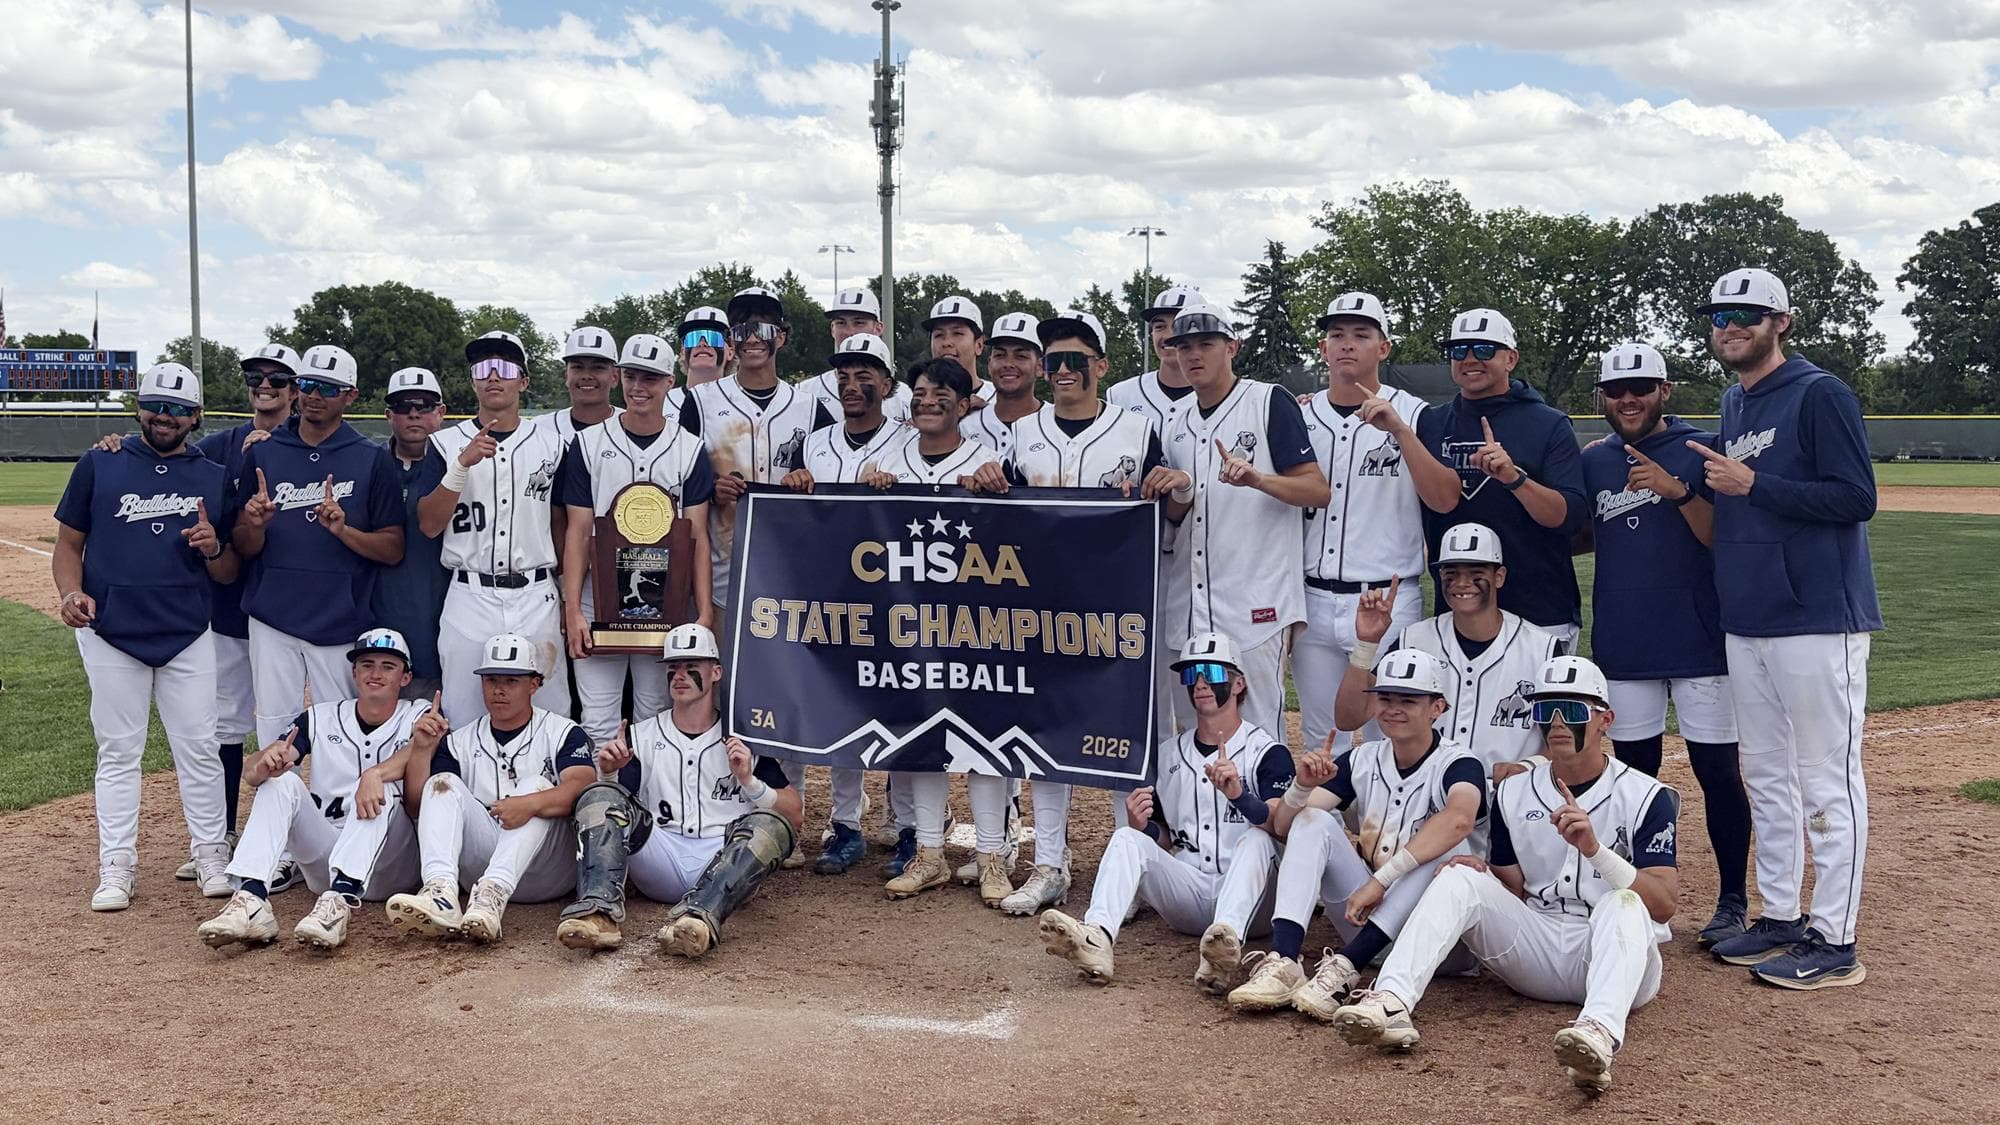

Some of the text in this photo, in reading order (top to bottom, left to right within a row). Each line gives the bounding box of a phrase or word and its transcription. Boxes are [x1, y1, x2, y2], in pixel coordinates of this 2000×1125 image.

[34, 353, 65, 361] STRIKE
[78, 353, 96, 361] OUT
[272, 480, 354, 508] Bulldgs
[453, 501, 486, 534] 20
[851, 540, 1031, 587] CHSAA
[632, 623, 672, 631] CHAMPION
[750, 596, 1146, 660] STATE CHAMPIONS
[857, 660, 1035, 694] BASEBALL
[750, 708, 776, 730] 3A
[1082, 735, 1131, 760] 2026
[657, 799, 674, 826] 9
